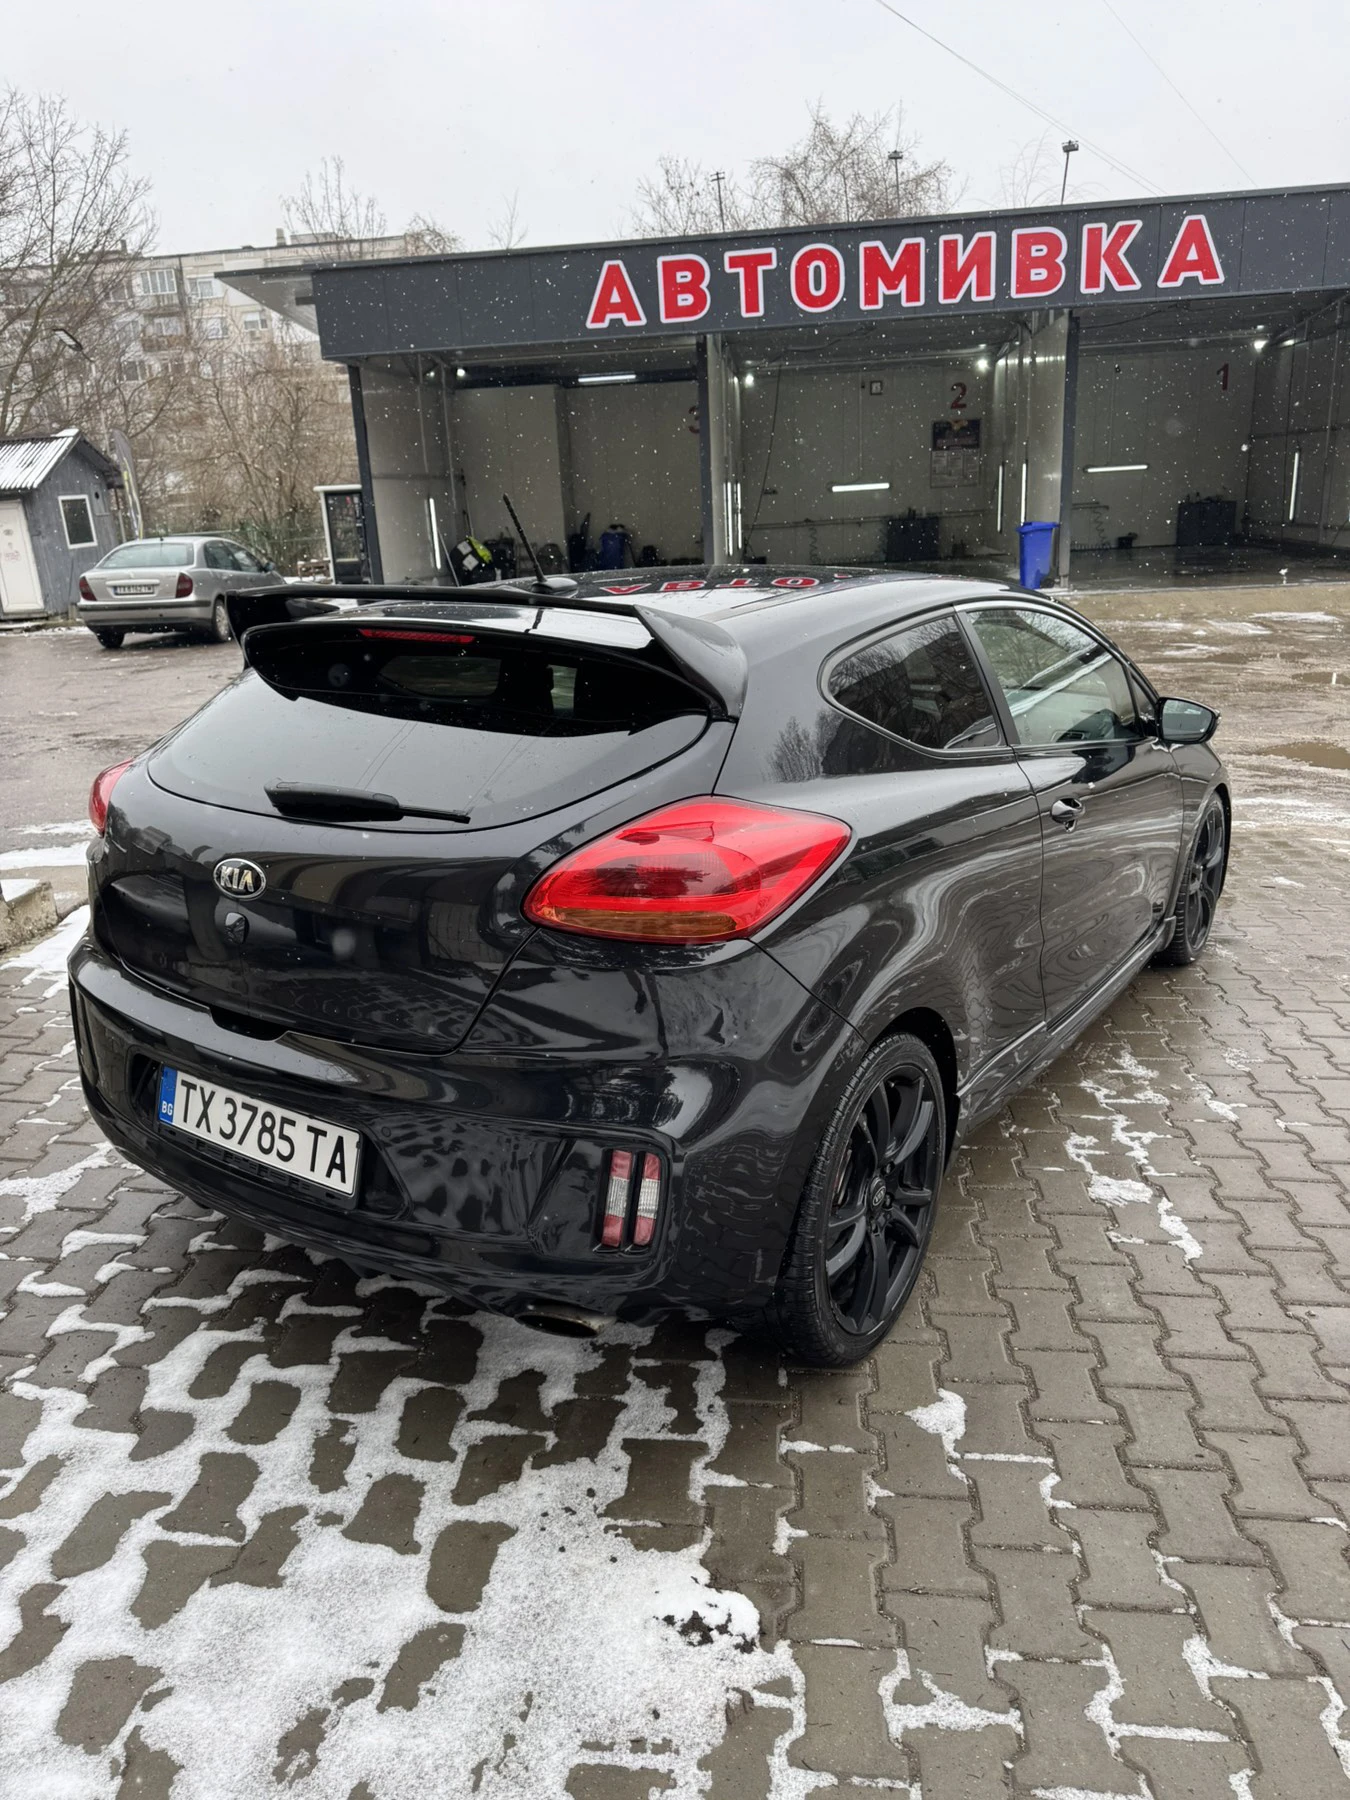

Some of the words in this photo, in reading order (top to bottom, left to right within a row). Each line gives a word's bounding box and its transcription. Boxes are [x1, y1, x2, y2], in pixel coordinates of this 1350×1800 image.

[586, 214, 1225, 329] АВТОМИВКА
[1216, 363, 1230, 391] 1
[950, 382, 967, 409] 2
[220, 865, 255, 893] KIA
[161, 1100, 174, 1117] BG
[219, 1097, 297, 1163] 3785
